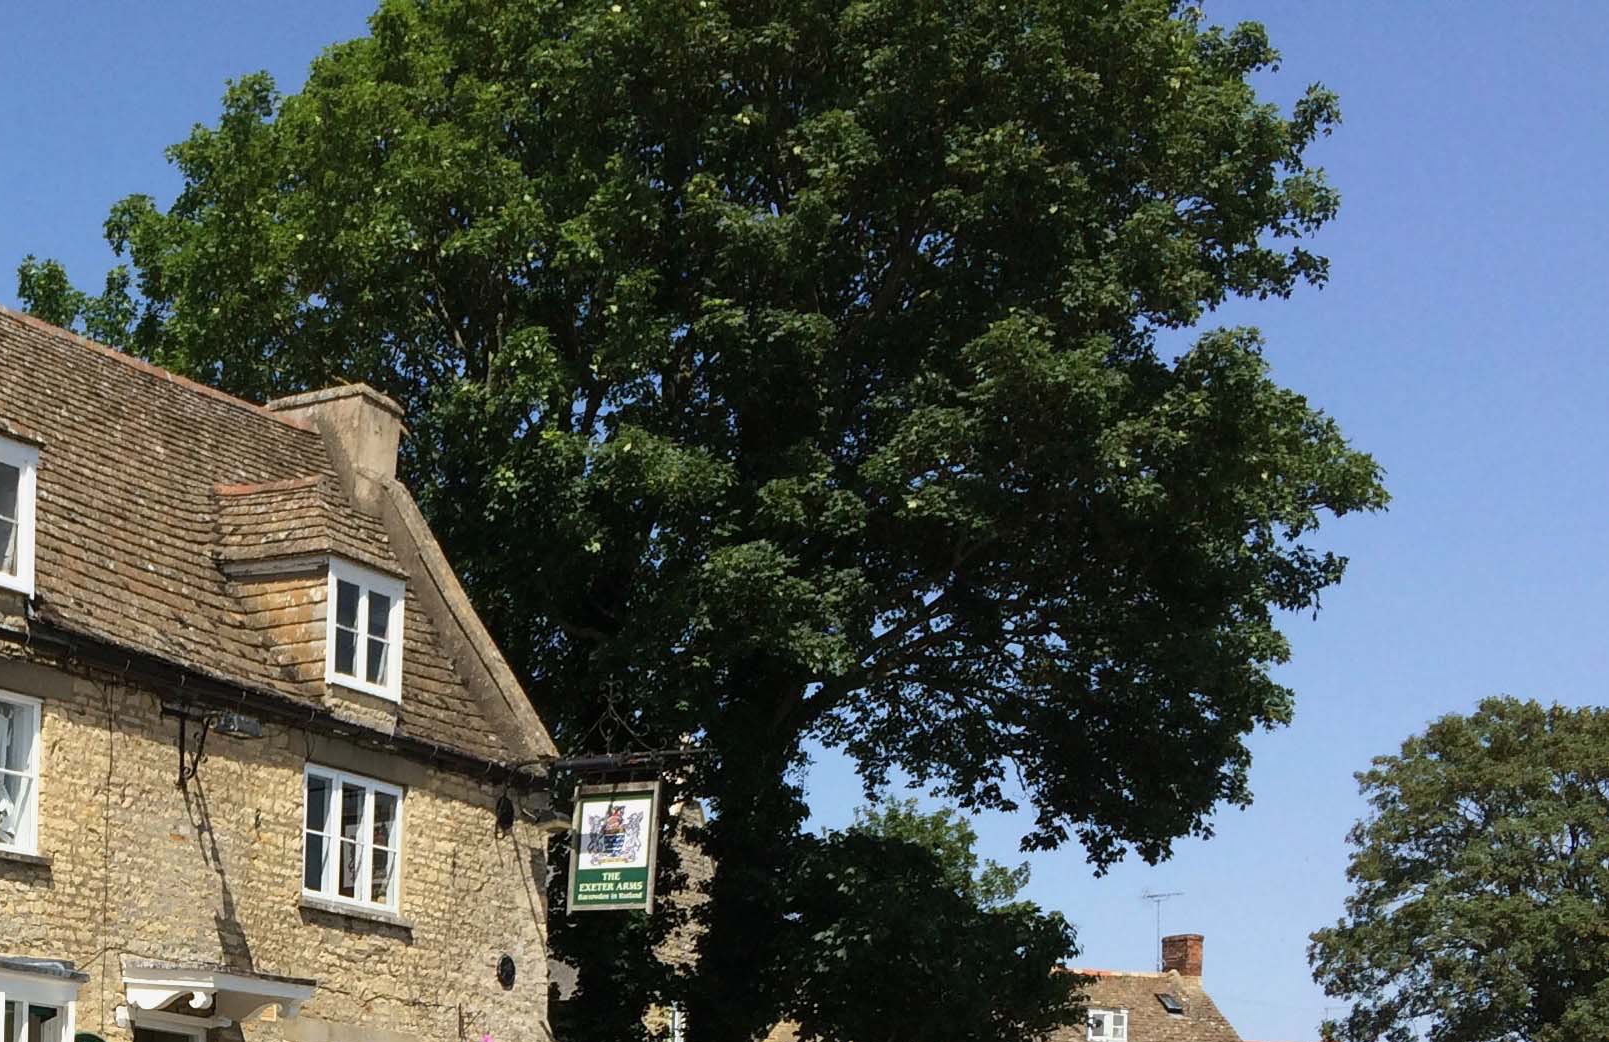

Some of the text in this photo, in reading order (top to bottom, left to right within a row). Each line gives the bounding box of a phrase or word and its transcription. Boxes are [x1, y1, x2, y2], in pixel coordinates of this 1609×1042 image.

[601, 871, 621, 881] THE
[579, 881, 643, 892] EXETER ARMS
